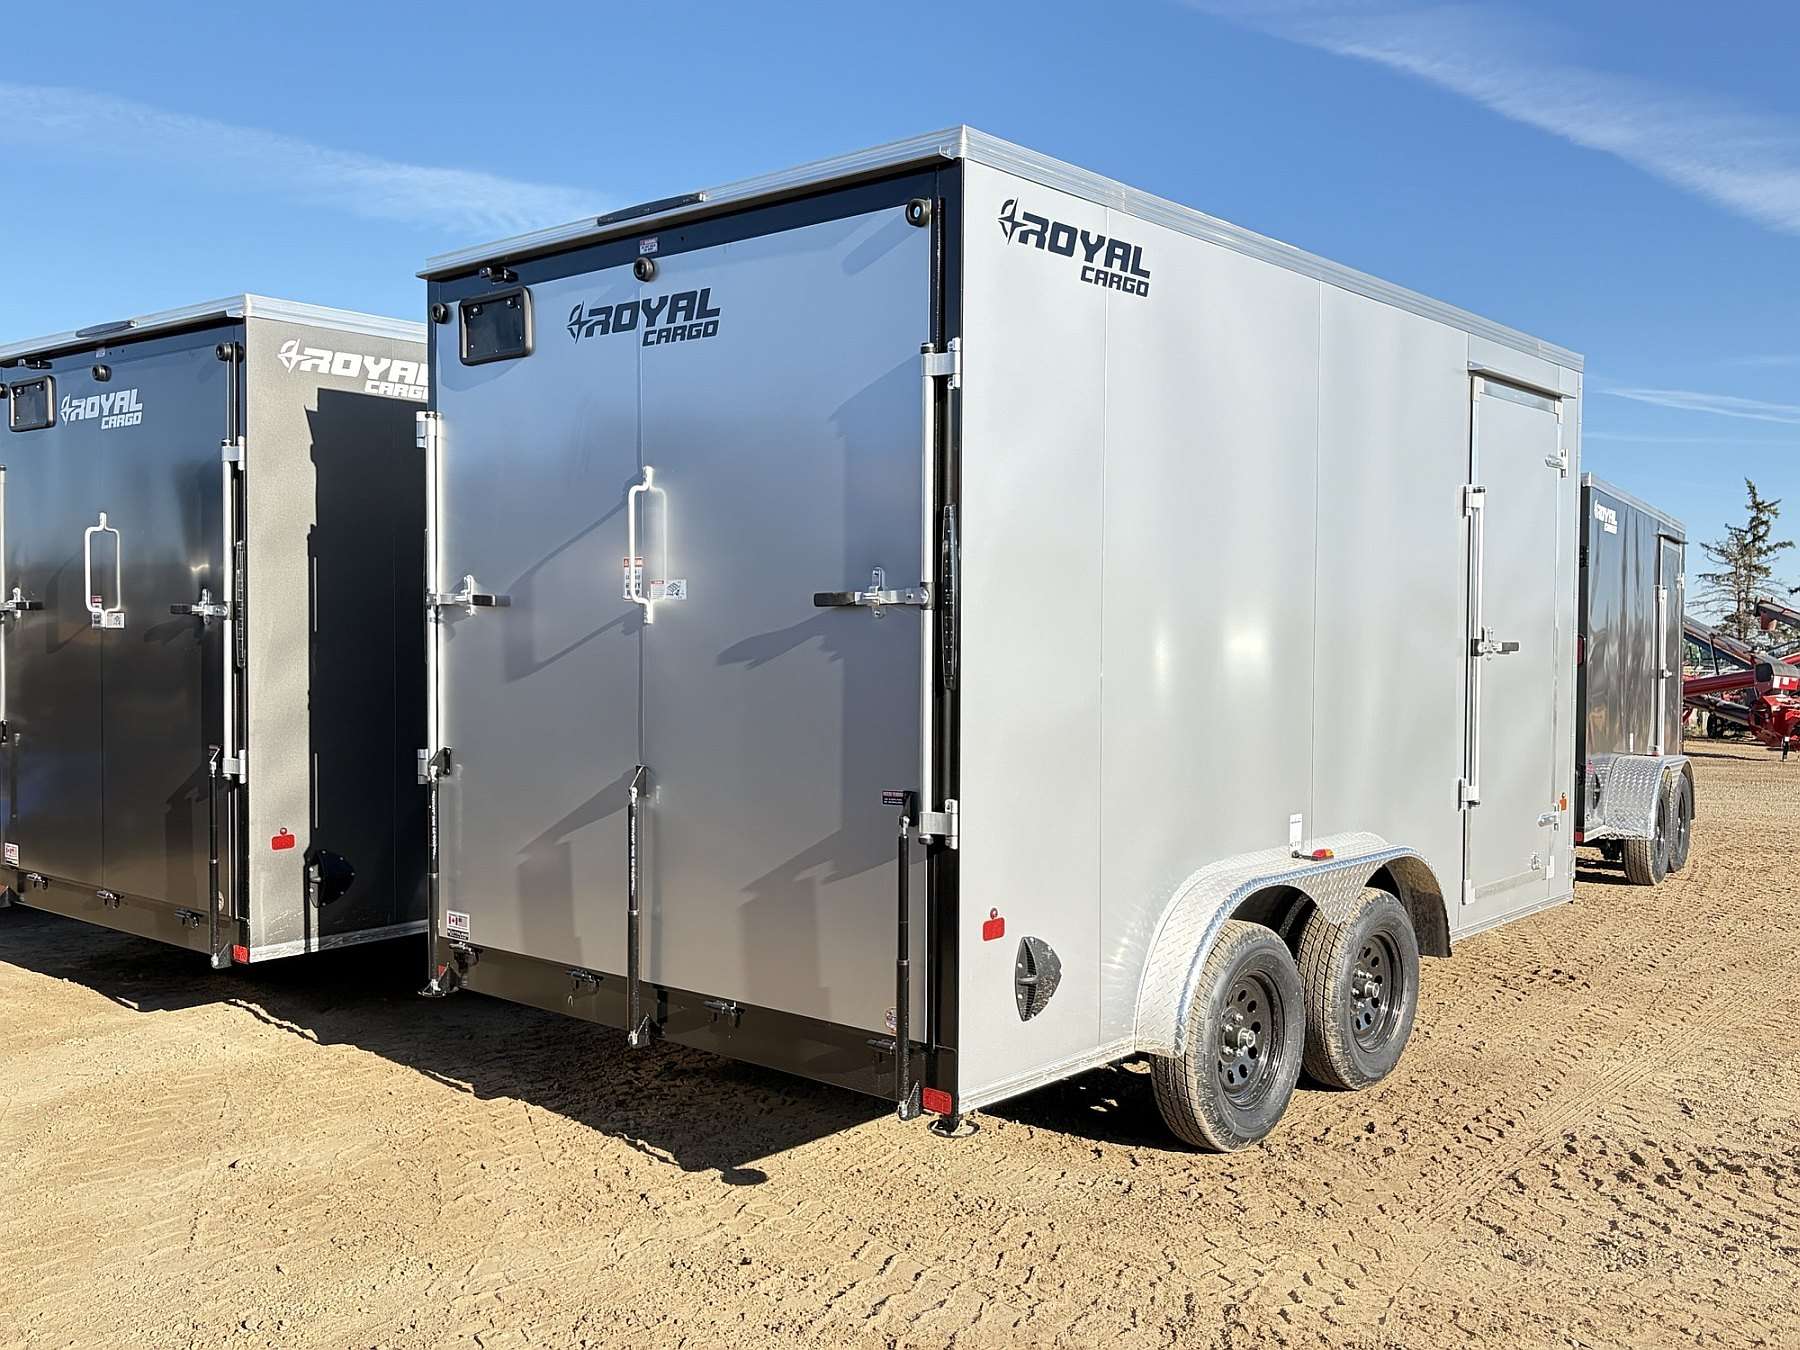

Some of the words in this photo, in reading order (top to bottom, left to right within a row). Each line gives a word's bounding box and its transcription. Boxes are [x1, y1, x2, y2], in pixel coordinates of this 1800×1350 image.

[1018, 211, 1151, 279] ROYAL
[1080, 265, 1150, 297] CARGO
[585, 287, 721, 338] ROYAL
[642, 320, 720, 347] CARGO
[70, 388, 143, 421] ROYAL
[101, 412, 142, 429] CARGO
